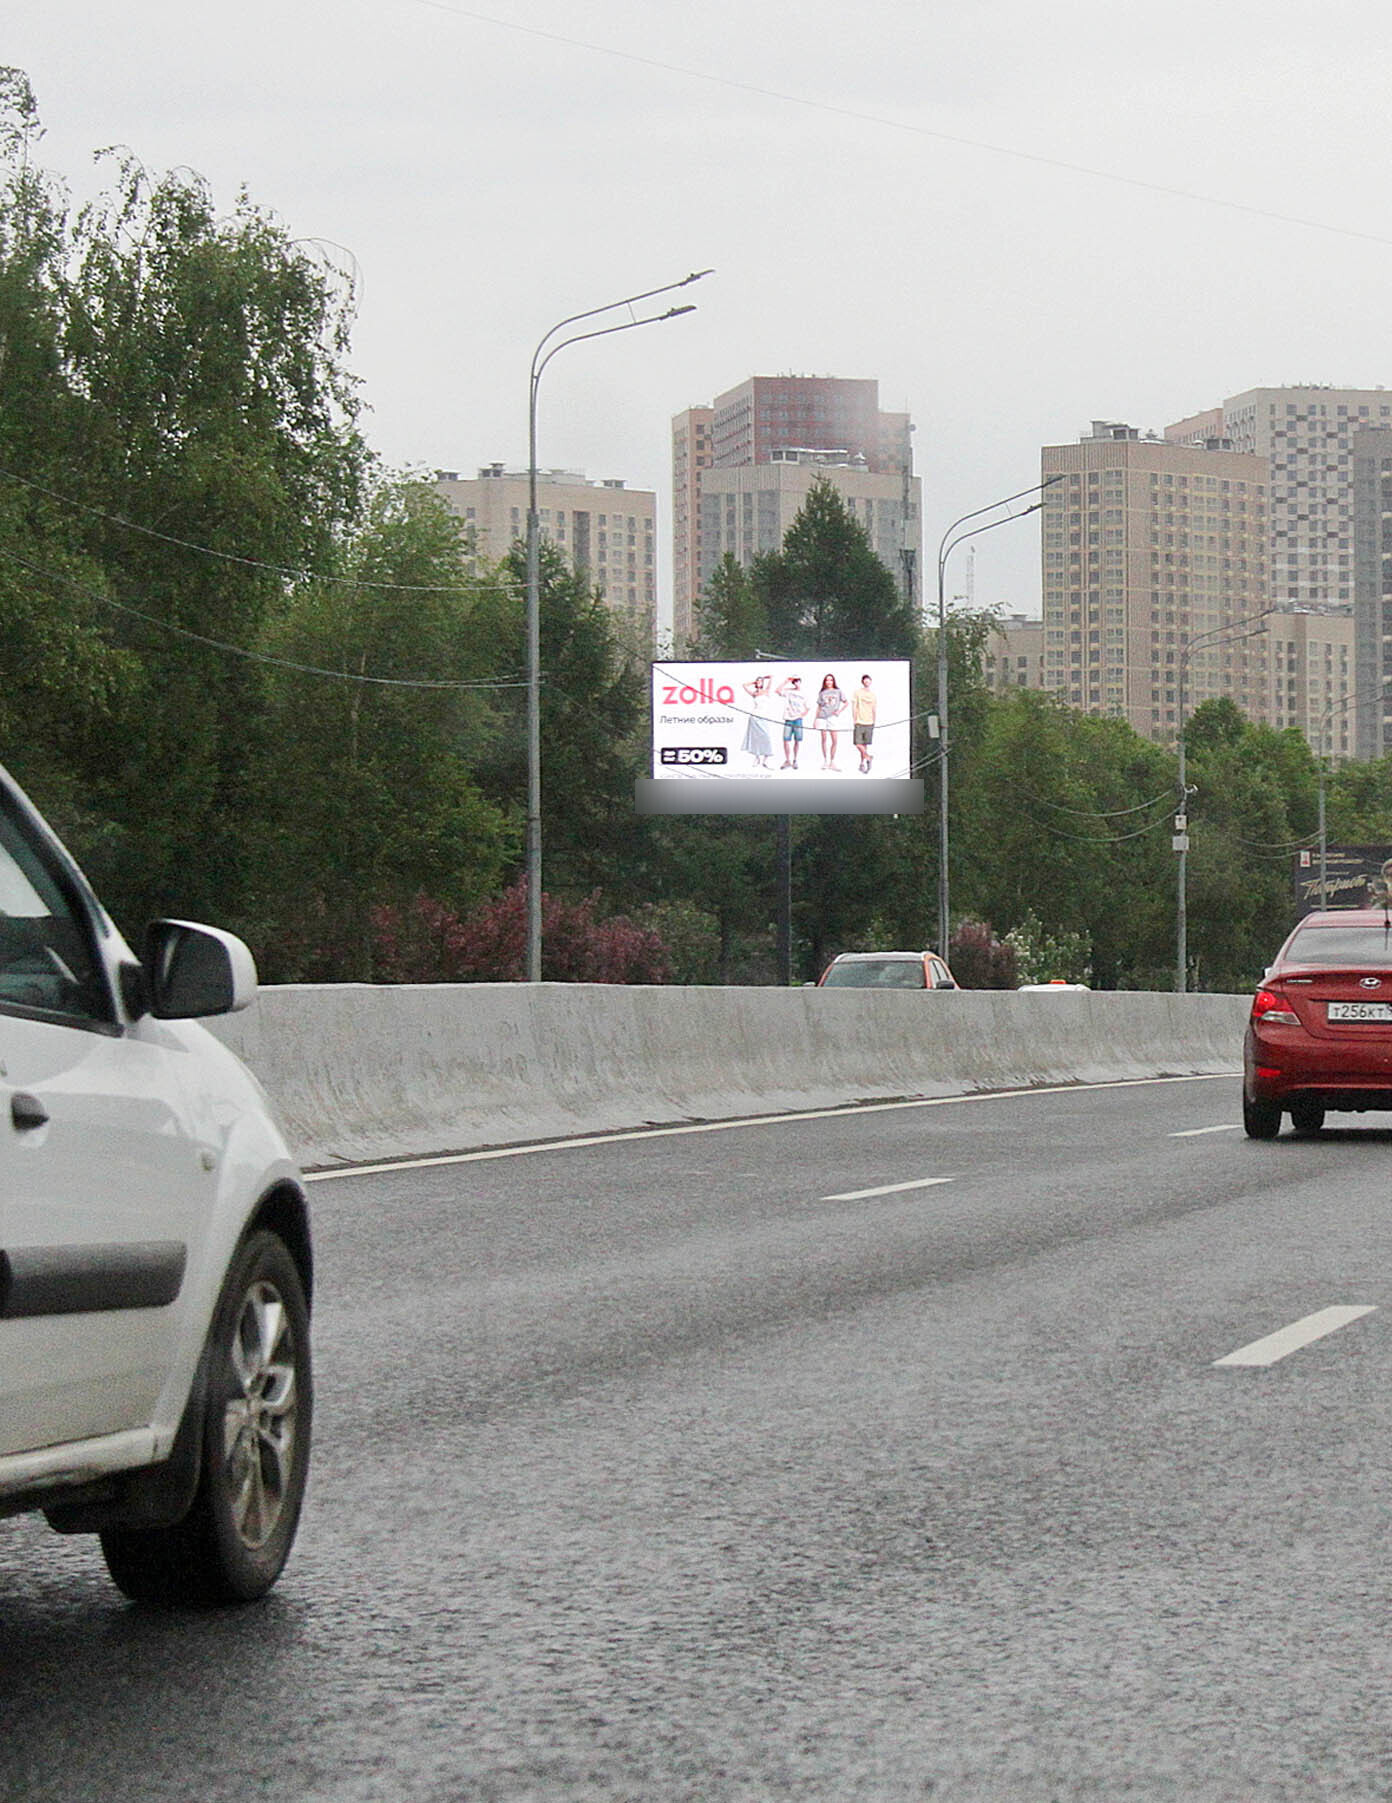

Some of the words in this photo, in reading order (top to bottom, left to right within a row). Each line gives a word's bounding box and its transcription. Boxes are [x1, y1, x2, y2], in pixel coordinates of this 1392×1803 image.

[662, 678, 735, 704] zolla
[659, 715, 696, 724] Летние
[697, 714, 734, 725] образы
